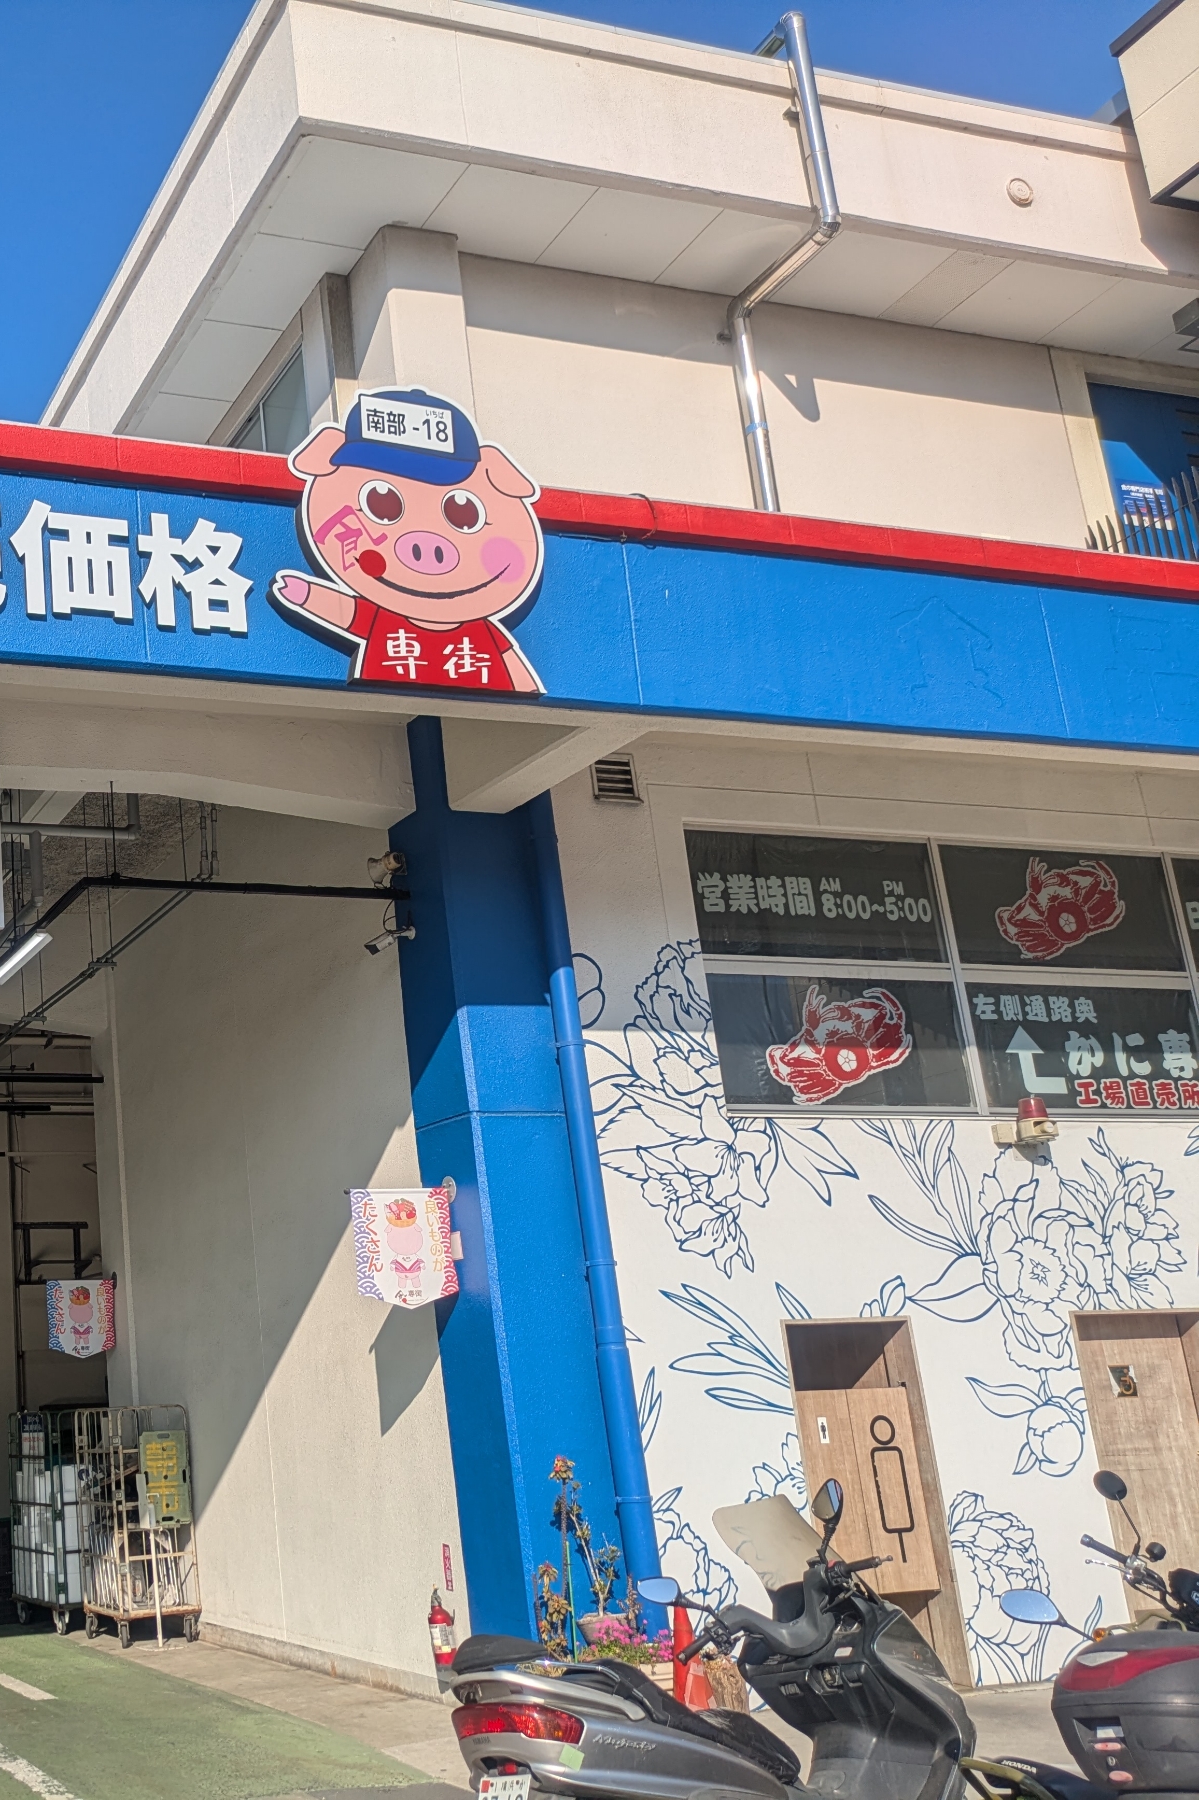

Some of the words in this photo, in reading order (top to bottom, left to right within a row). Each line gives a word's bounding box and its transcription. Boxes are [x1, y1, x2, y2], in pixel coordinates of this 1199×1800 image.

[425, 409, 445, 420] いちば
[381, 629, 492, 684] 専街
[697, 872, 816, 917] 営業時間
[819, 877, 842, 893] AM
[882, 880, 905, 896] PM
[972, 993, 1098, 1024] 左側通路奥
[1074, 1078, 1199, 1108] 工場直売所
[361, 1201, 383, 1273] たくさん
[424, 1200, 446, 1272] 良いものが
[53, 1287, 66, 1335] たくさん
[472, 1735, 491, 1745] YAMAHA
[1001, 1759, 1037, 1775] HONDA
